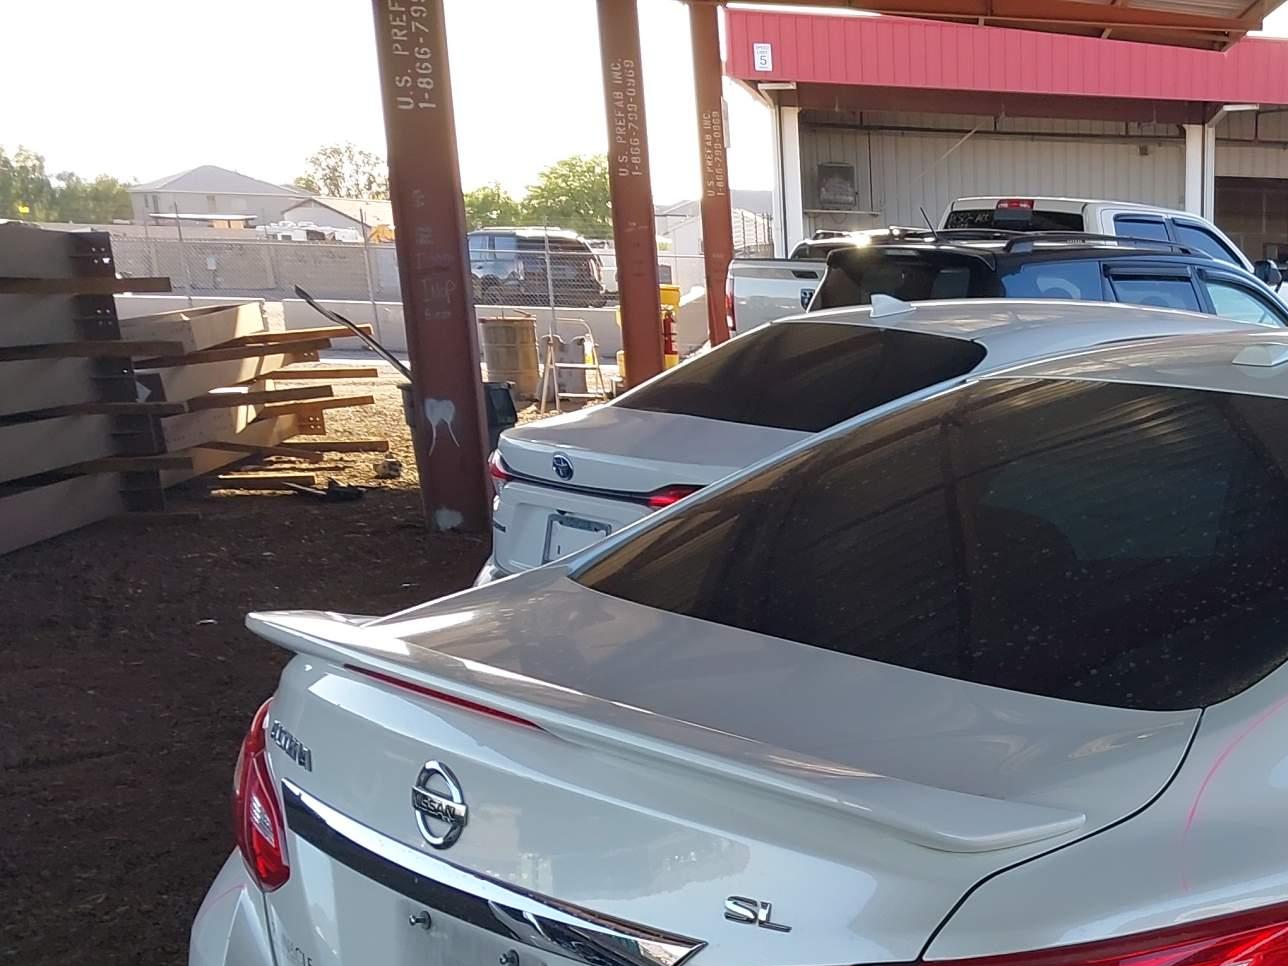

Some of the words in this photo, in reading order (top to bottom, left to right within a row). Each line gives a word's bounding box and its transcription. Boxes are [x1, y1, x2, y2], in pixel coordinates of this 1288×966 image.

[410, 0, 437, 108] 1-866-79
[759, 55, 767, 65] 5
[395, 69, 415, 110] U.S.
[613, 90, 627, 144] PREFAB
[618, 152, 630, 176] U.S.
[723, 895, 793, 933] SL
